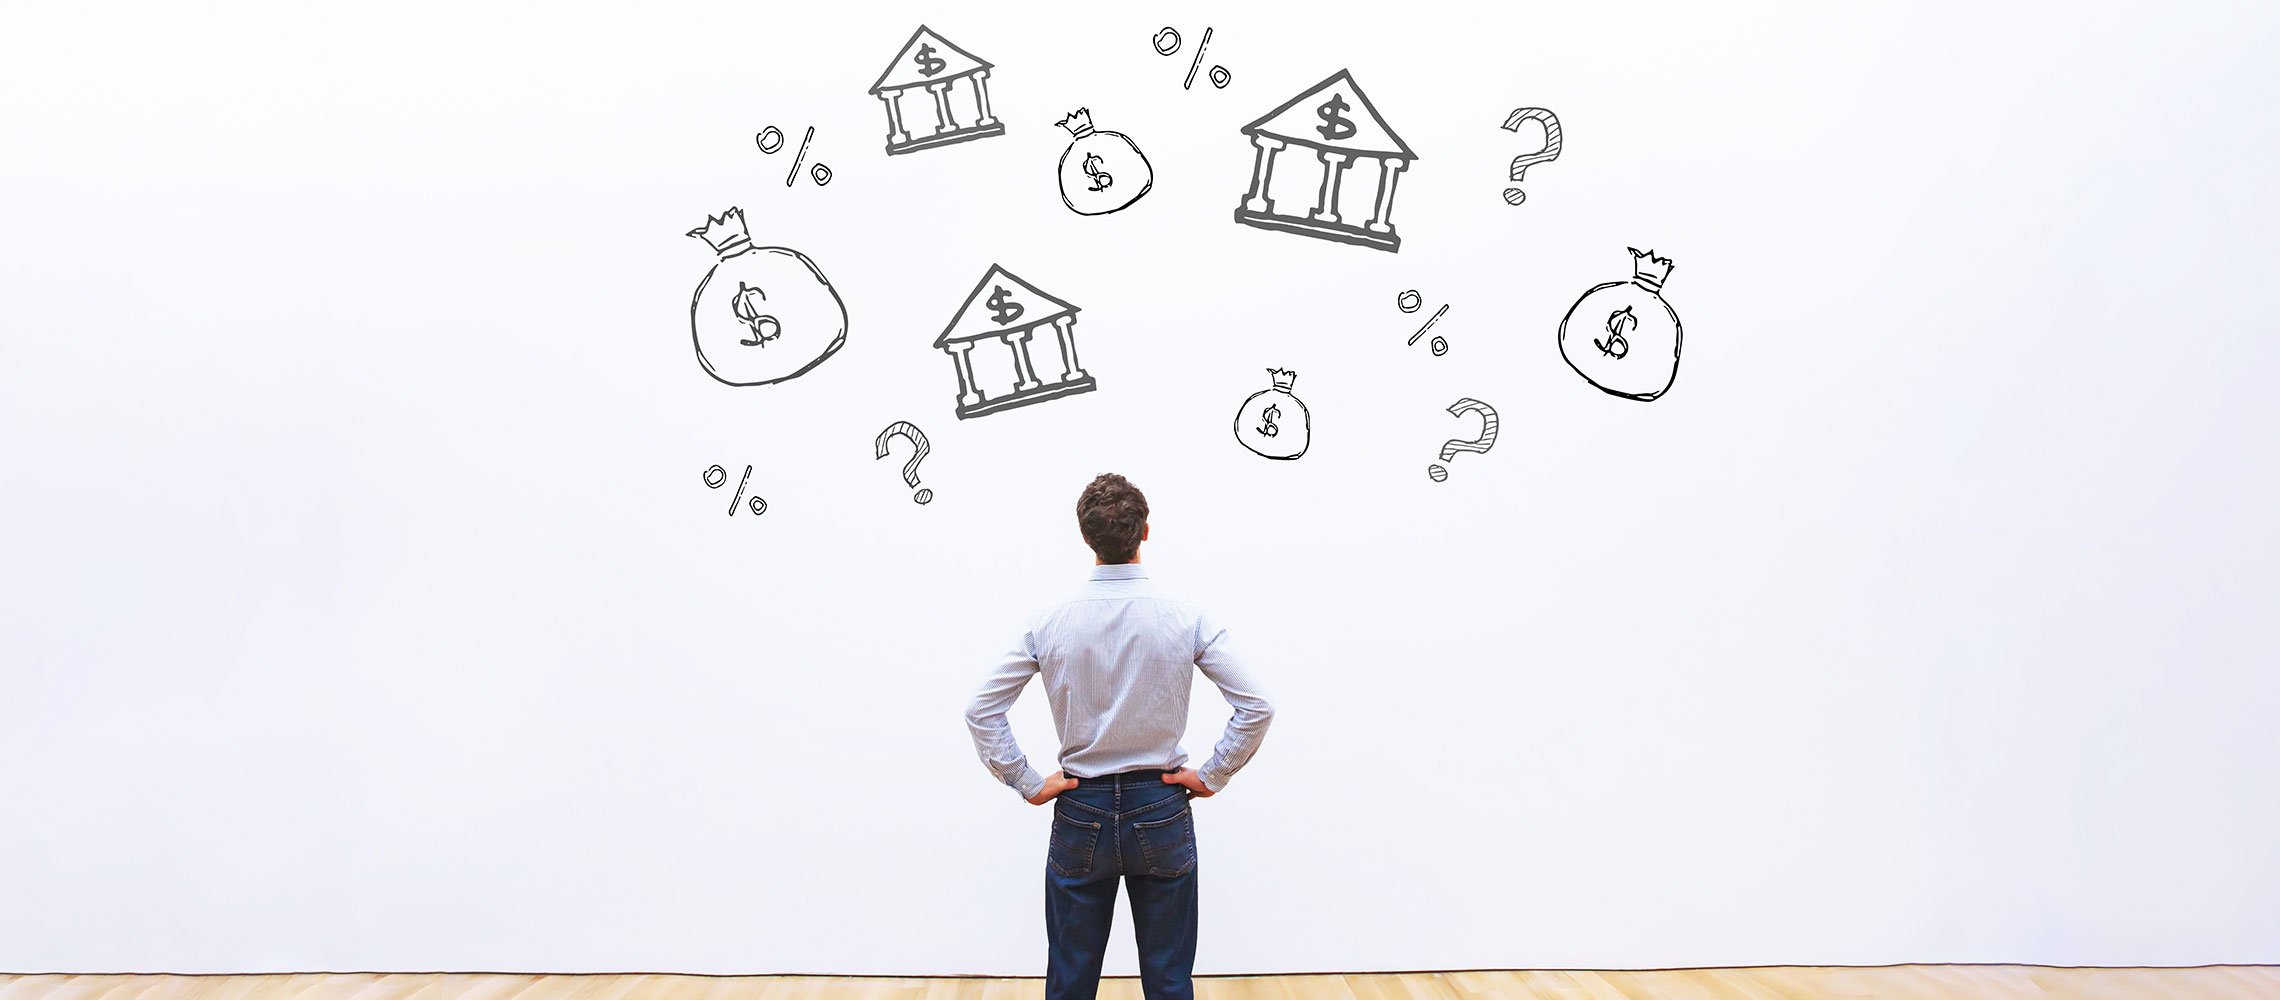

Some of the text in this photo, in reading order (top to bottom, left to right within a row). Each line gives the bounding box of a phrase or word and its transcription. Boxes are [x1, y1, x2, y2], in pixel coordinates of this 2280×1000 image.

[914, 43, 946, 77] $
[1153, 27, 1231, 90] %
[1316, 93, 1357, 140] $
[756, 126, 832, 187] %
[1083, 152, 1113, 192] $
[1501, 107, 1562, 206] ?
[732, 281, 781, 348] $
[986, 285, 1024, 326] $
[1398, 290, 1449, 356] %
[1594, 305, 1637, 360] $
[1256, 403, 1281, 438] $
[1429, 398, 1499, 482] ?
[703, 465, 767, 516] %
[875, 421, 933, 505] ?
